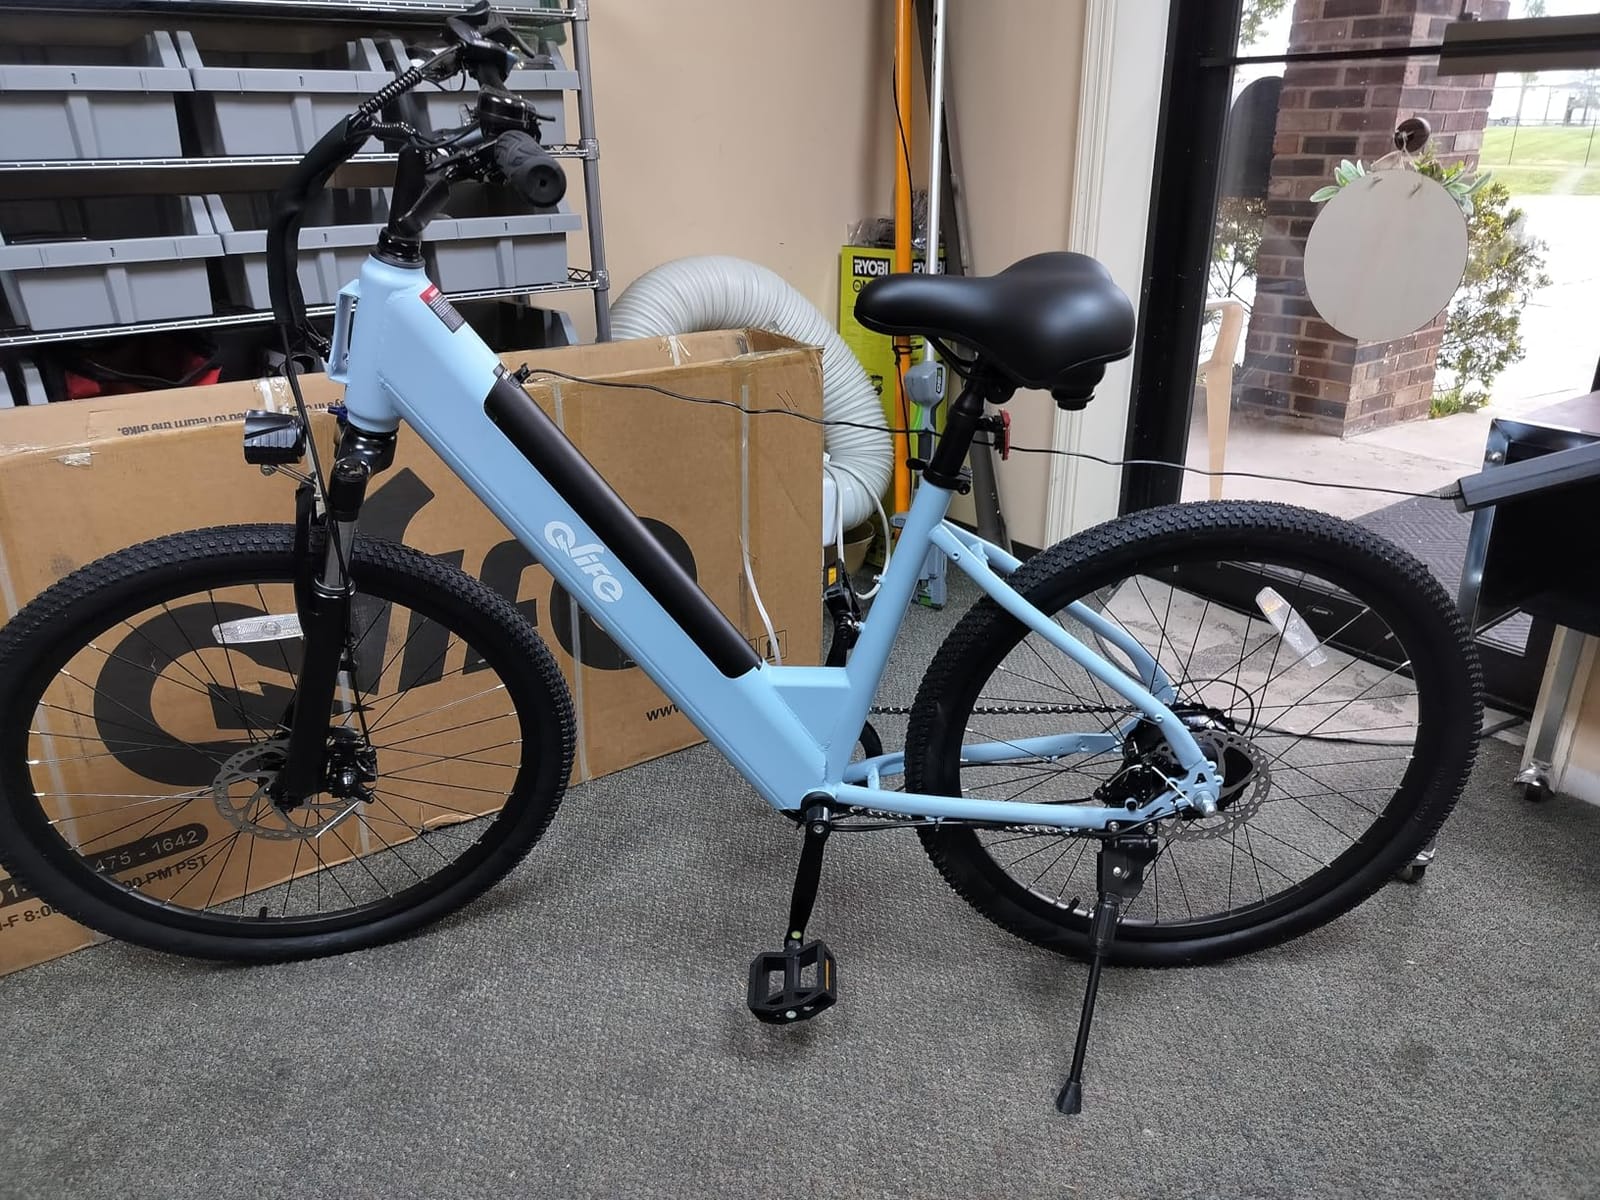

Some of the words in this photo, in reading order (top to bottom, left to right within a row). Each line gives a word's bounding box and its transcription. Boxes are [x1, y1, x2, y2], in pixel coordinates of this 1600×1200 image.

[854, 258, 889, 276] RYOBI
[913, 261, 945, 275] RYBI
[152, 830, 198, 854] 1642
[146, 867, 171, 884] PM
[175, 855, 207, 874] PST
